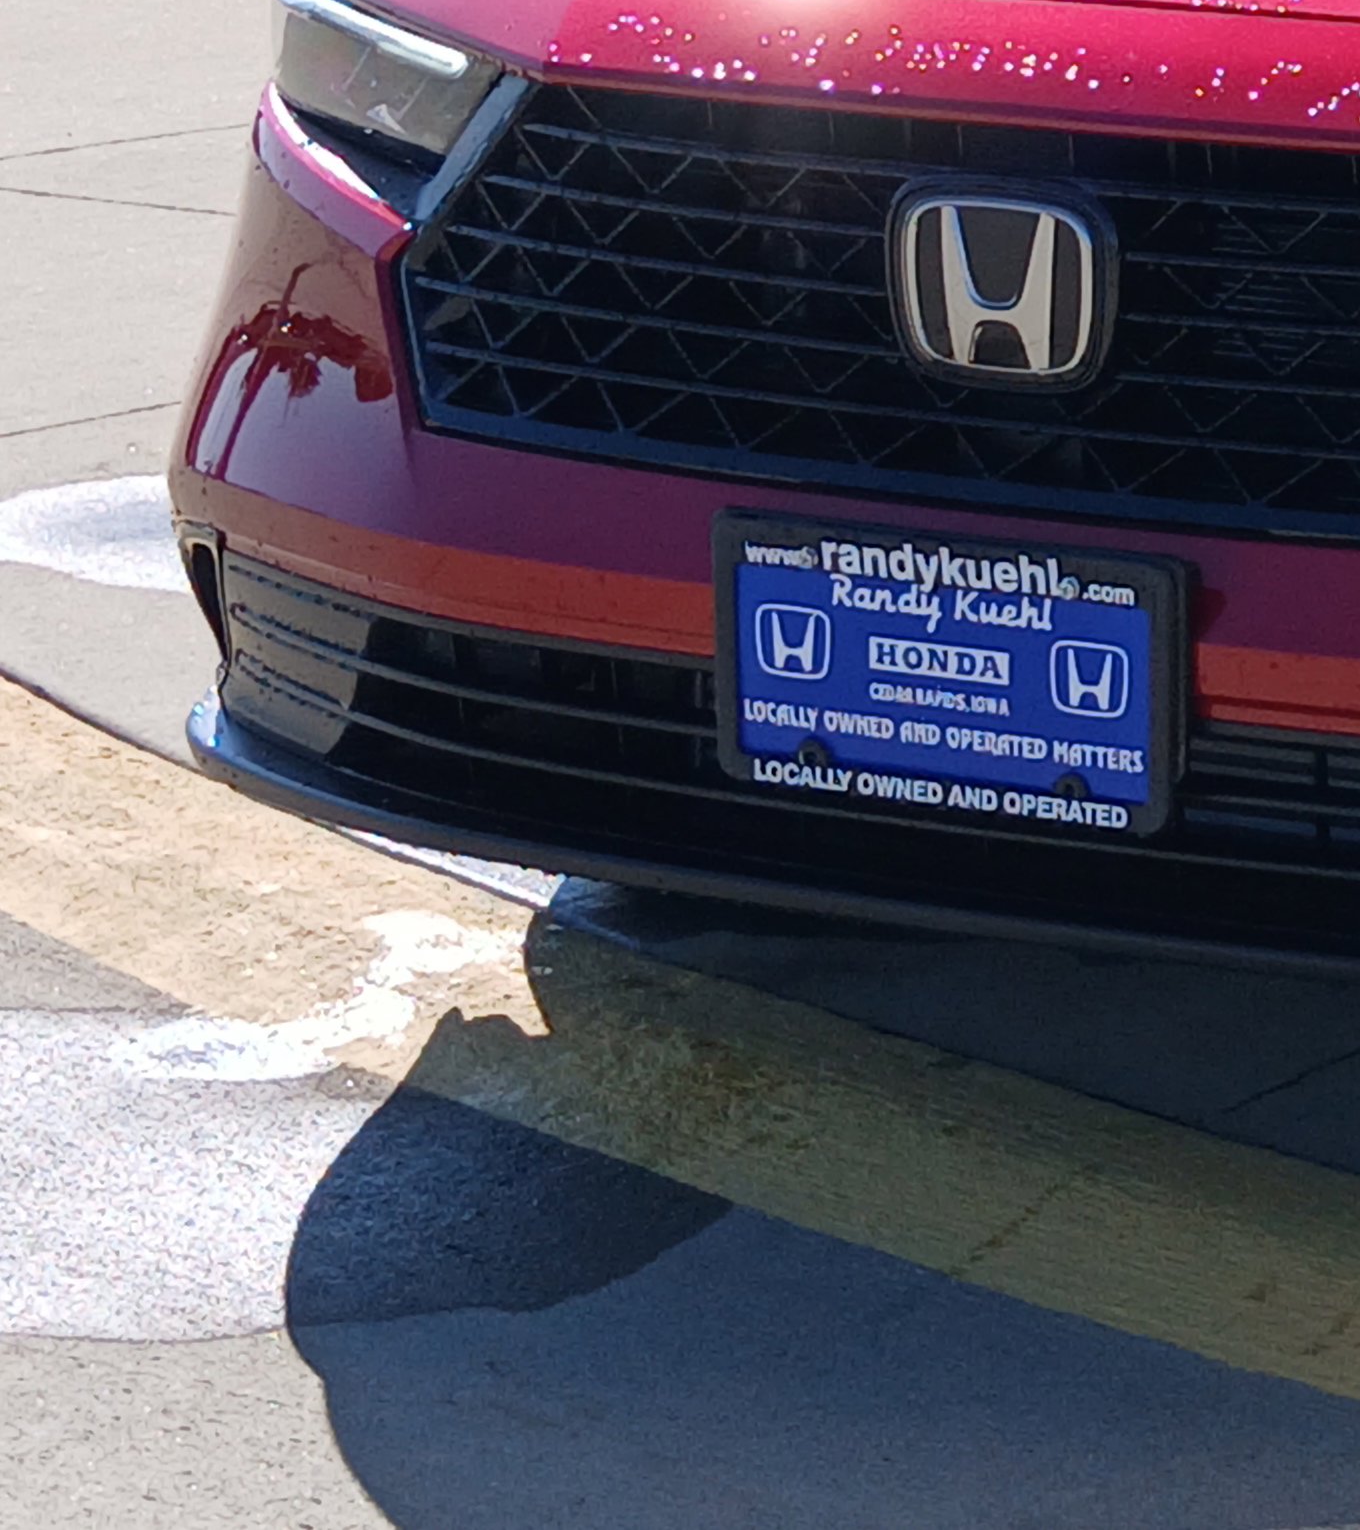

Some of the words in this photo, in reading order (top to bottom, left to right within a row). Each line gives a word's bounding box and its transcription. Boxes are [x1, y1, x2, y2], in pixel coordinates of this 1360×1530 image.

[830, 573, 942, 633] Randy
[954, 589, 1053, 631] Kuehl
[875, 642, 1003, 680] HONDA
[743, 698, 819, 732] LOCALLY
[824, 710, 895, 740] OWNED
[900, 721, 941, 746] AND
[946, 726, 1048, 760] OPERATED
[1053, 740, 1145, 774] MATTERS
[753, 758, 853, 793] LOCALLY
[857, 772, 944, 805] OWNED
[948, 784, 998, 811] AND
[1003, 791, 1129, 830] OPERATED
